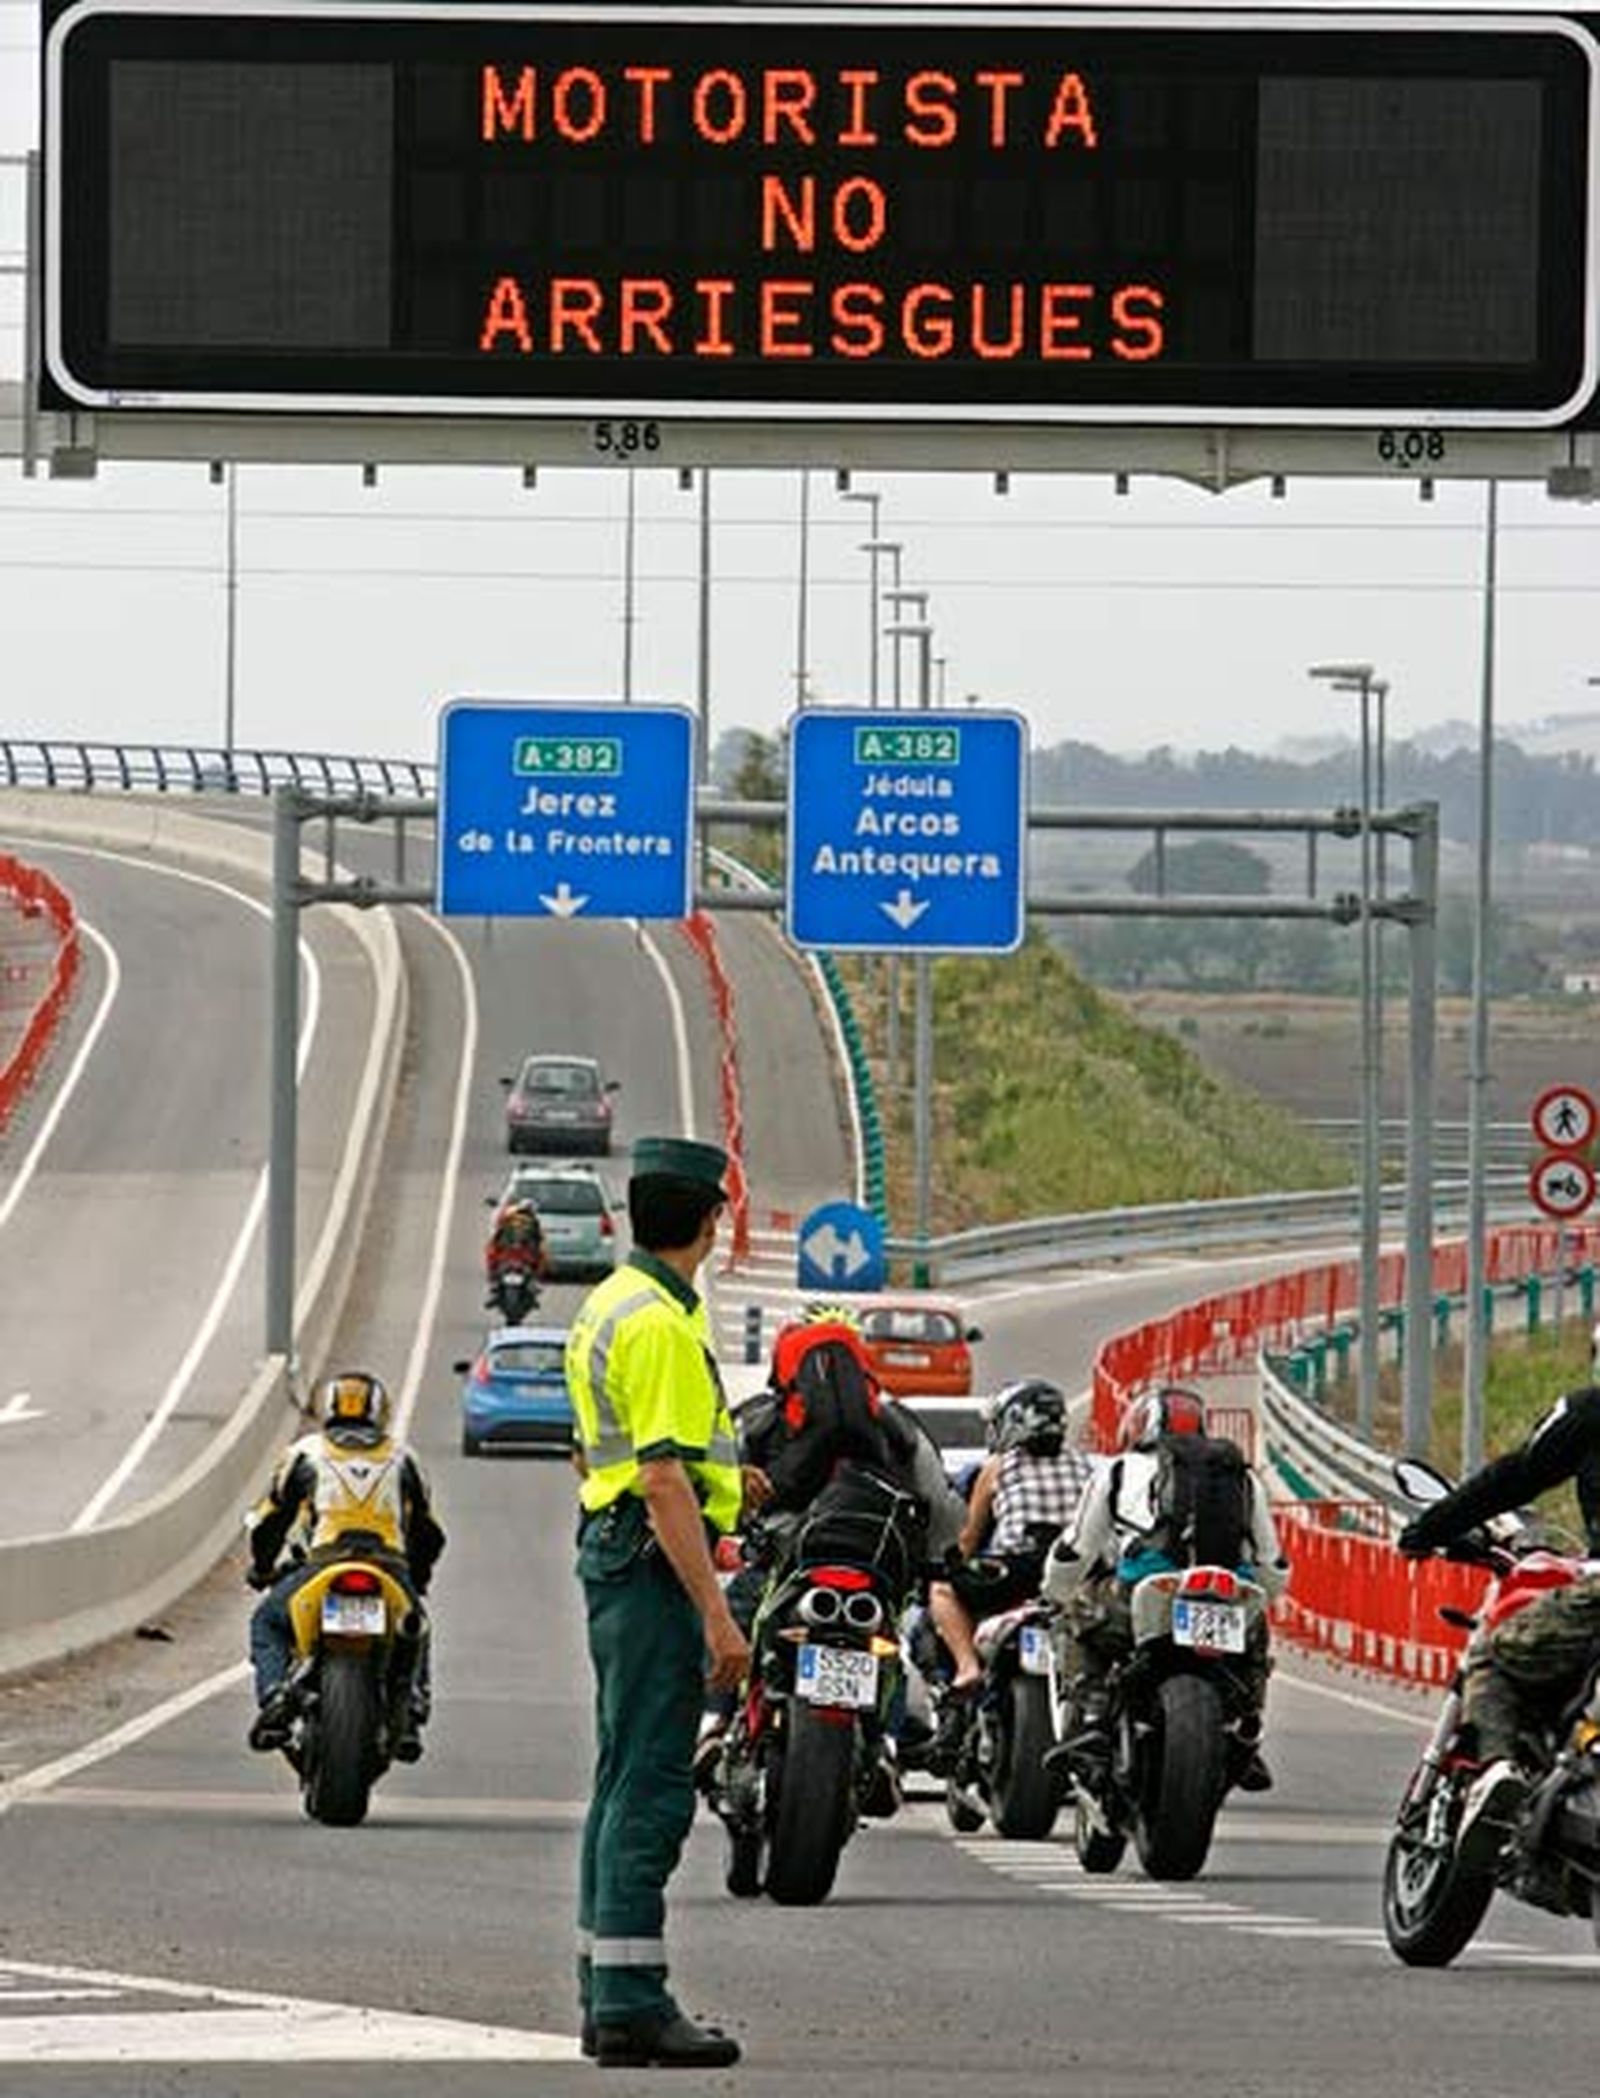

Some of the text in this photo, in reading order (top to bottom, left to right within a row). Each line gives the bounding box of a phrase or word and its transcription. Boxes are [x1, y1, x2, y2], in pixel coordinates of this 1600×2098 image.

[482, 66, 1098, 147] MOTORISTA
[762, 176, 887, 252] NO
[480, 278, 1164, 360] ARRIESGUES
[521, 745, 614, 769] A-382
[861, 733, 954, 759] A-382
[862, 774, 953, 798] Jédula
[520, 787, 616, 817] Jerez
[855, 807, 960, 836] Arcos
[458, 831, 672, 855] de la Frontera
[812, 844, 1001, 880] Antequera
